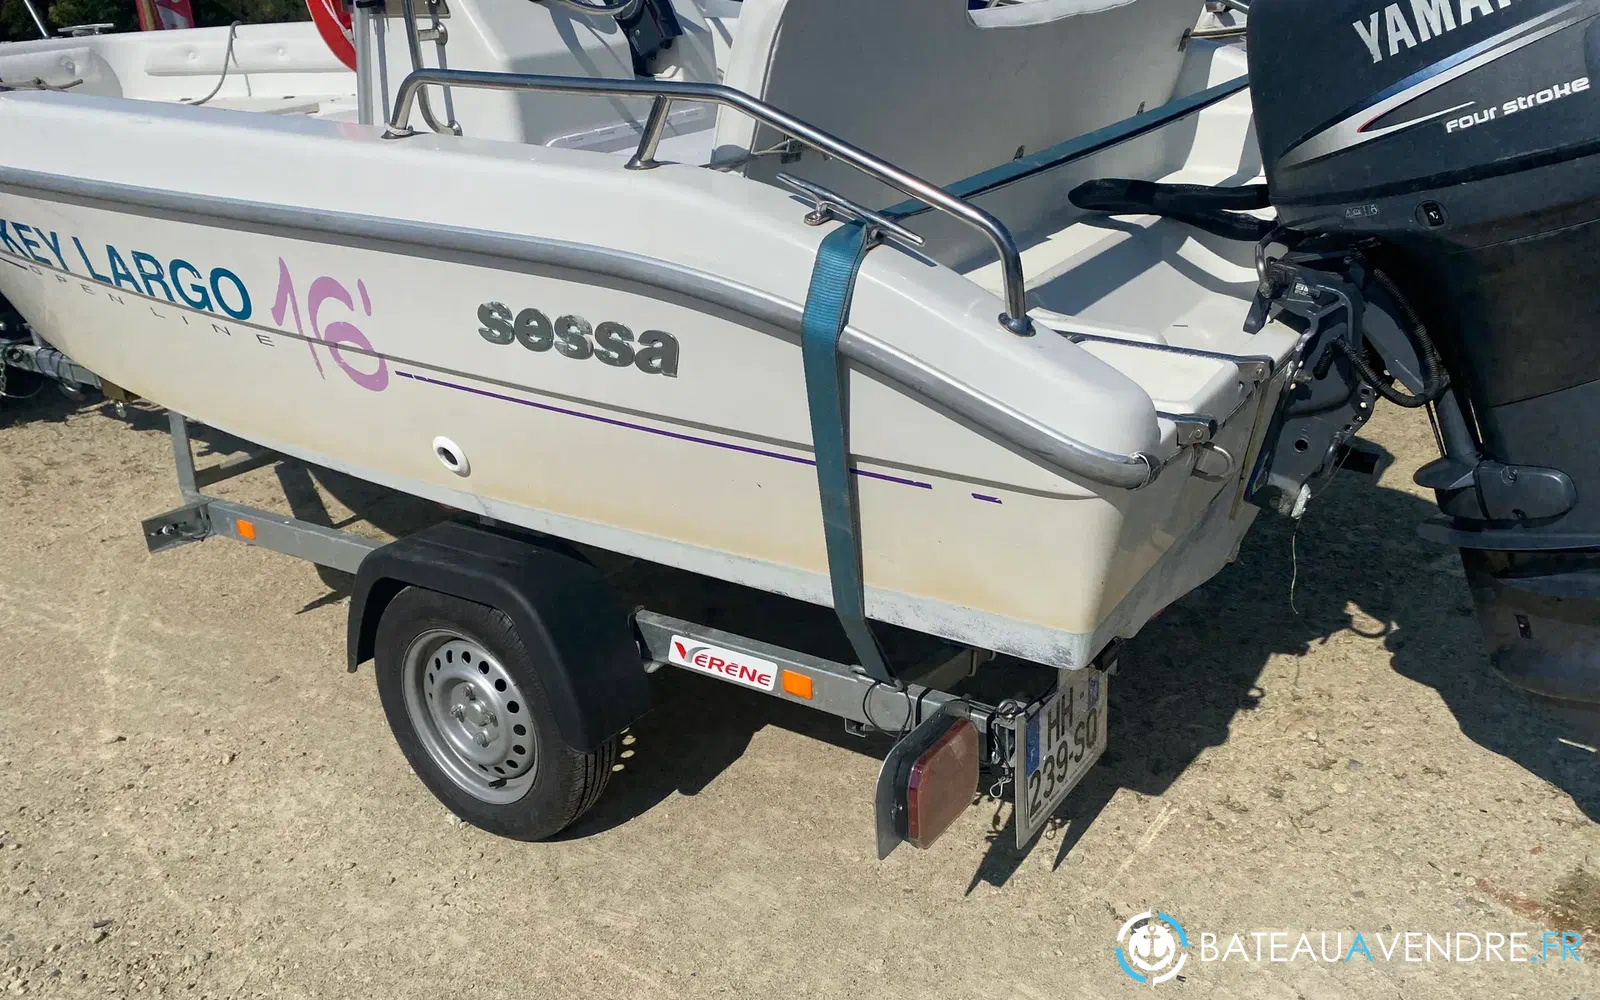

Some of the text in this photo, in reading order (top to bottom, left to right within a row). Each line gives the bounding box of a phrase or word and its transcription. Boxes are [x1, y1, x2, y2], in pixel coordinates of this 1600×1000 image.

[0, 218, 70, 272] KEY
[71, 236, 252, 321] LARGO
[29, 264, 275, 348] OPEN LINE
[477, 301, 680, 378] sessa
